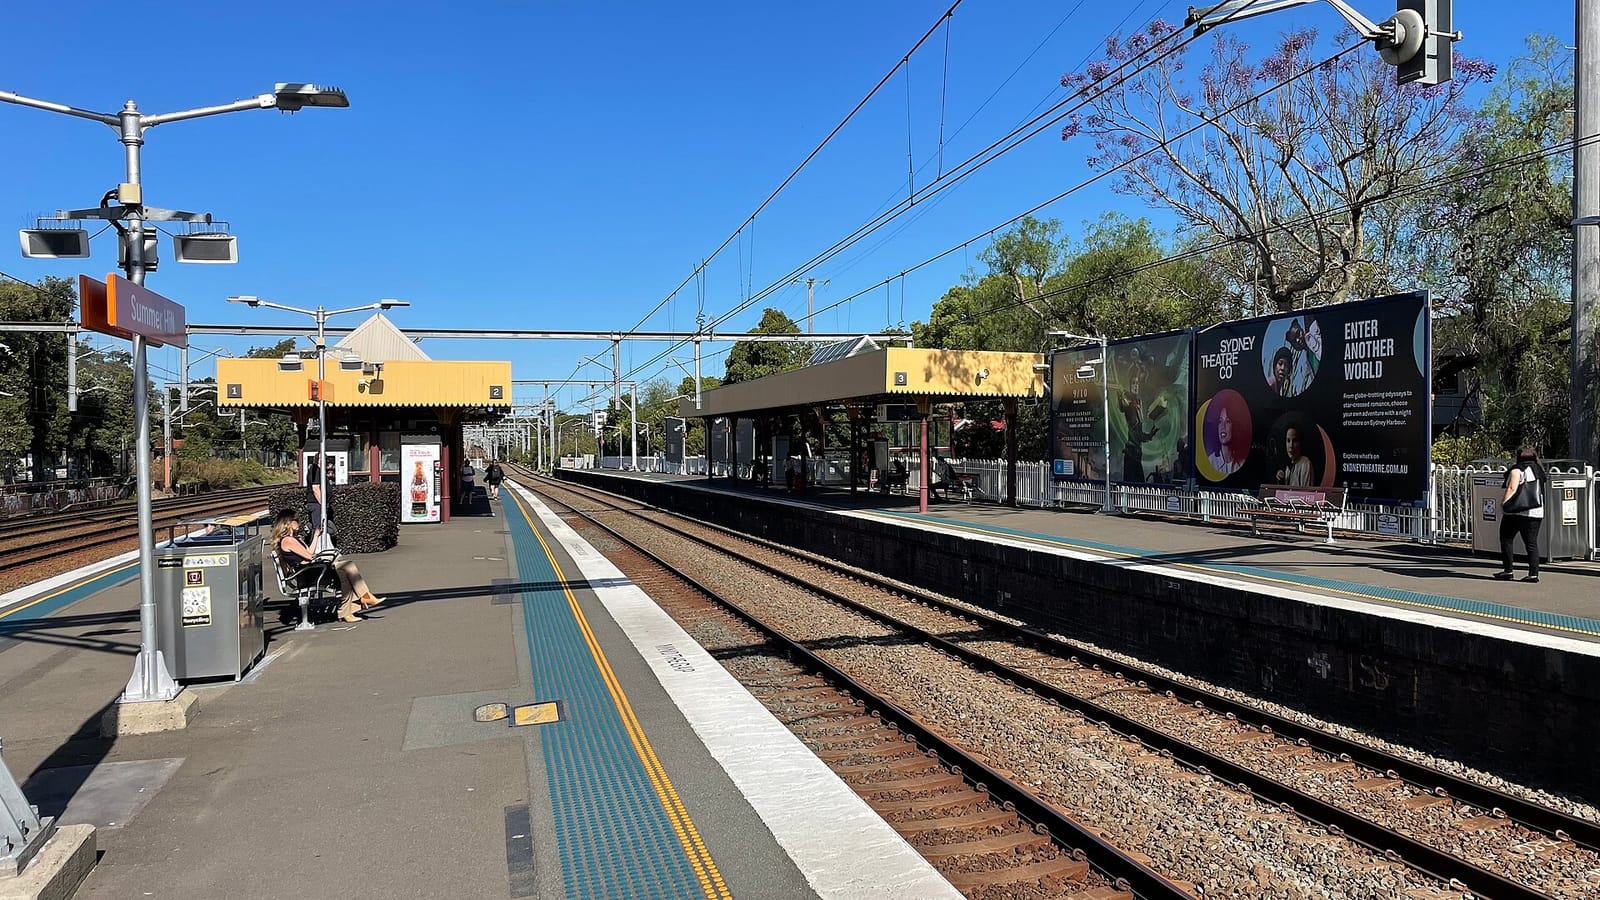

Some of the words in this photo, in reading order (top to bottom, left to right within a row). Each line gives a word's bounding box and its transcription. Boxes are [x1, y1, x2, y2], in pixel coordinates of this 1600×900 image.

[131, 294, 162, 330] Summer
[163, 309, 175, 335] Hill
[1344, 319, 1378, 340] ENTER
[1220, 336, 1255, 352] SYDNEY
[1344, 338, 1394, 360] ANOTHER
[1201, 352, 1239, 369] THEATRE
[1219, 365, 1232, 379] CO
[1344, 360, 1382, 380] WORLD
[898, 374, 904, 383] 3
[493, 388, 499, 396] 2
[1072, 388, 1088, 399] 9/10
[1370, 419, 1386, 427] Sydney
[1342, 463, 1408, 474] SYDNEYTHEATRE.COM.AU
